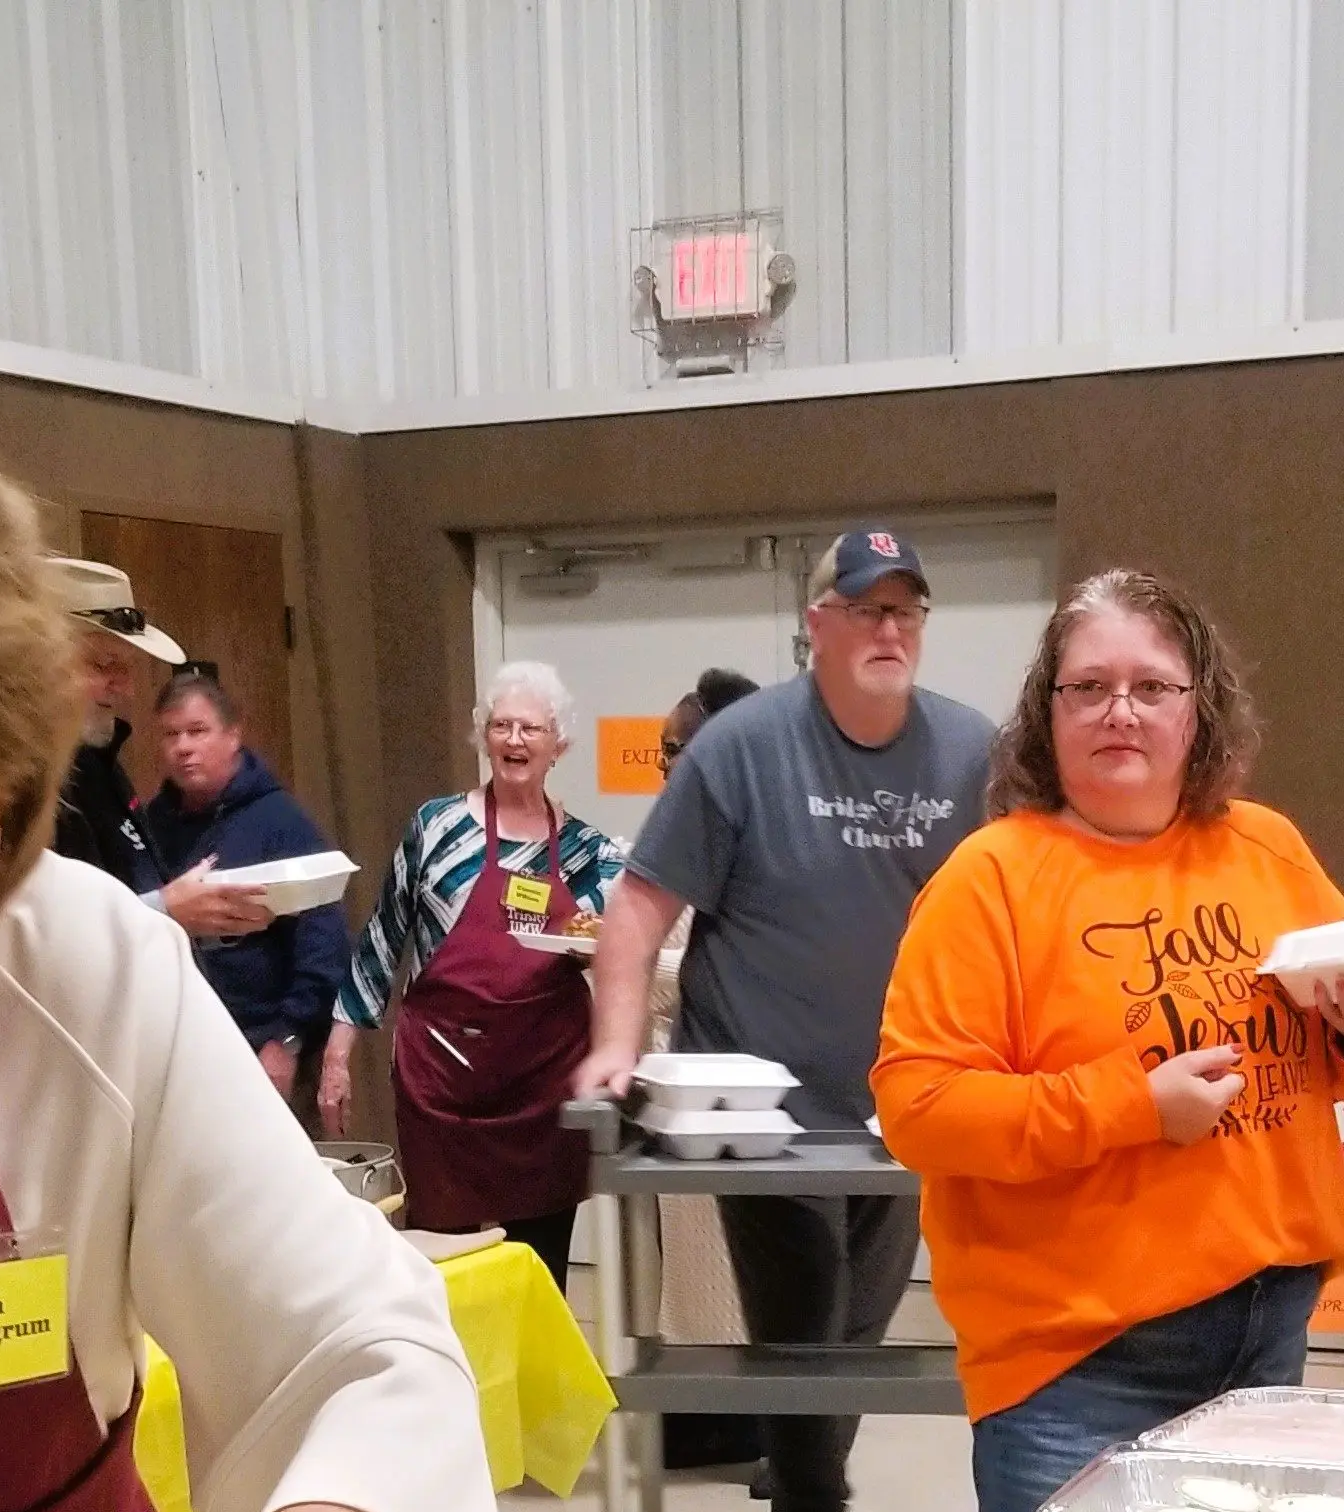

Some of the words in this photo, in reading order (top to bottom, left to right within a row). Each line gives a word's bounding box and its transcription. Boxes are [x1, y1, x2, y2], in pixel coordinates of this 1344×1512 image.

[676, 236, 750, 306] EXIT
[622, 749, 660, 765] EXIT
[509, 920, 546, 935] UMW
[1082, 902, 1260, 996] Fall
[1202, 967, 1269, 1007] FOR
